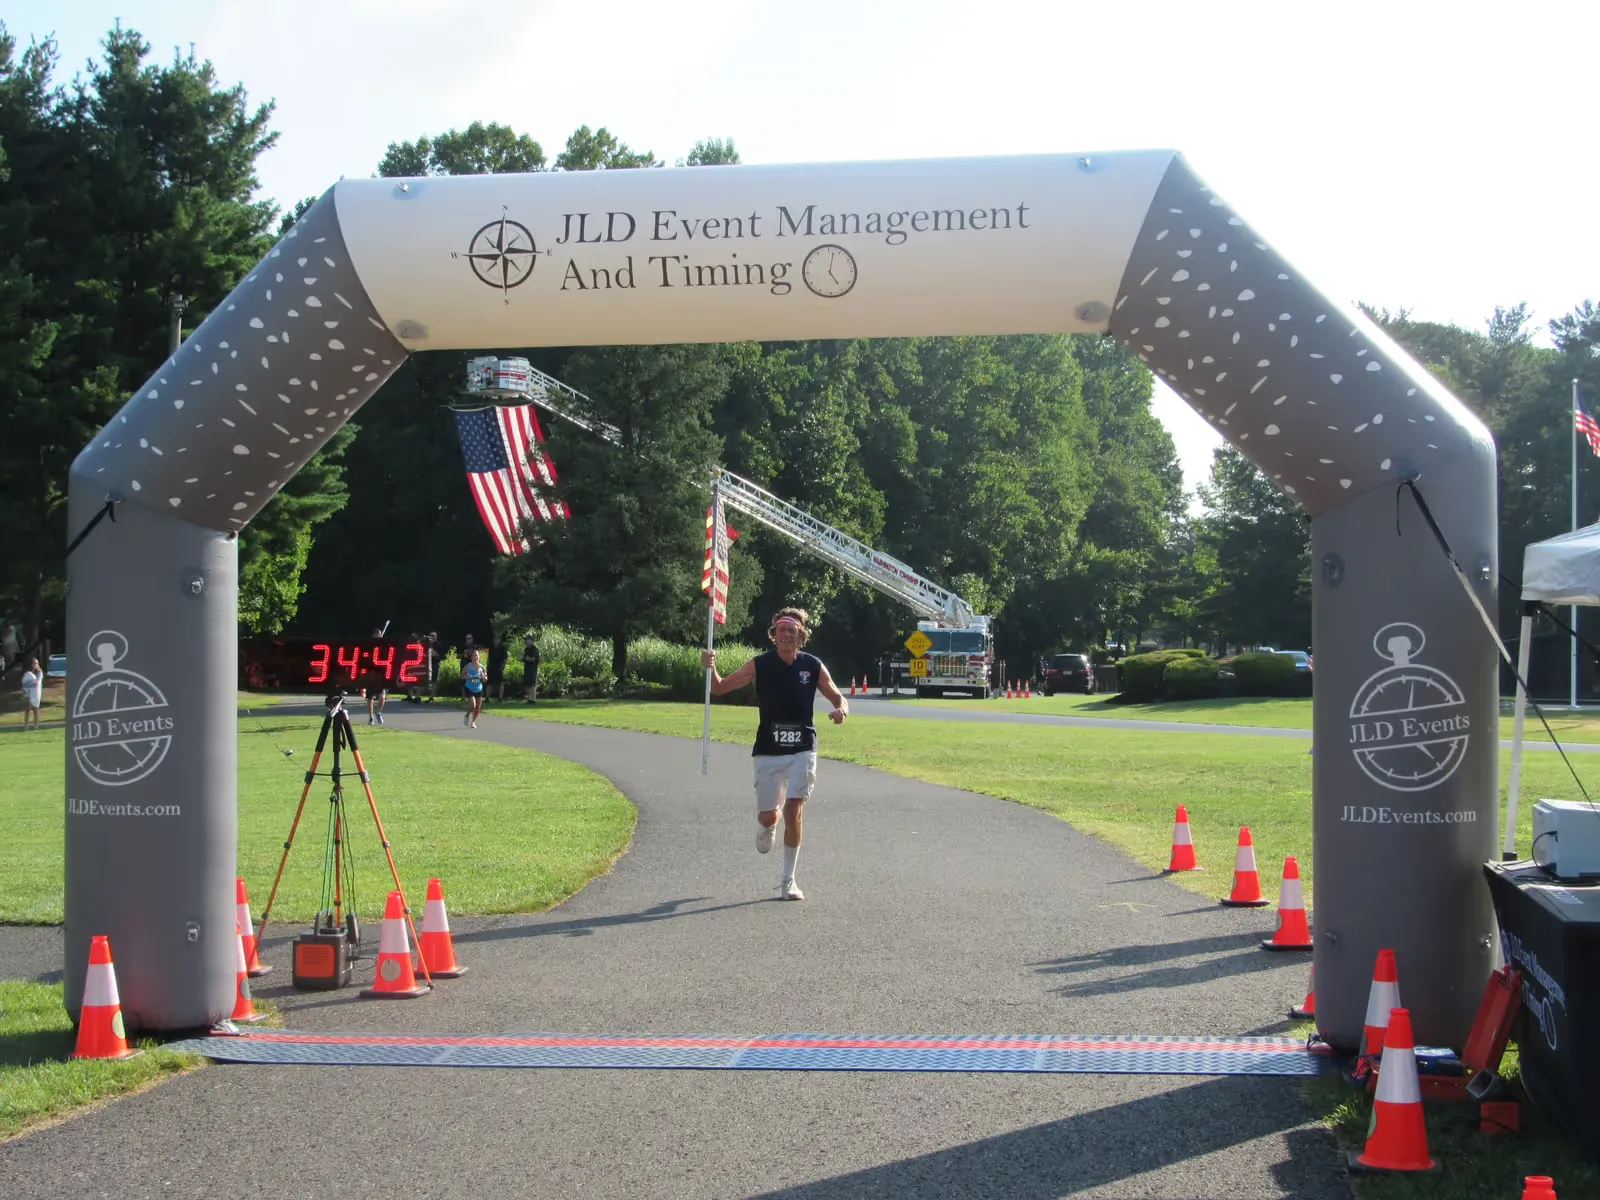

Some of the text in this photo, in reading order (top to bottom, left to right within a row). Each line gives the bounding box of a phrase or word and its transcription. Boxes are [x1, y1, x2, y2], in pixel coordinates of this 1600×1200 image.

[555, 201, 1031, 245] JLD Event Management
[559, 252, 793, 295] And Timing
[308, 643, 425, 682] 34:42
[913, 661, 924, 670] 10
[72, 715, 174, 741] JLD Events
[772, 730, 802, 743] 1282
[1349, 713, 1471, 744] JLD Events
[68, 798, 181, 816] JLDEvents.com
[1340, 805, 1477, 825] JLDEvents.com
